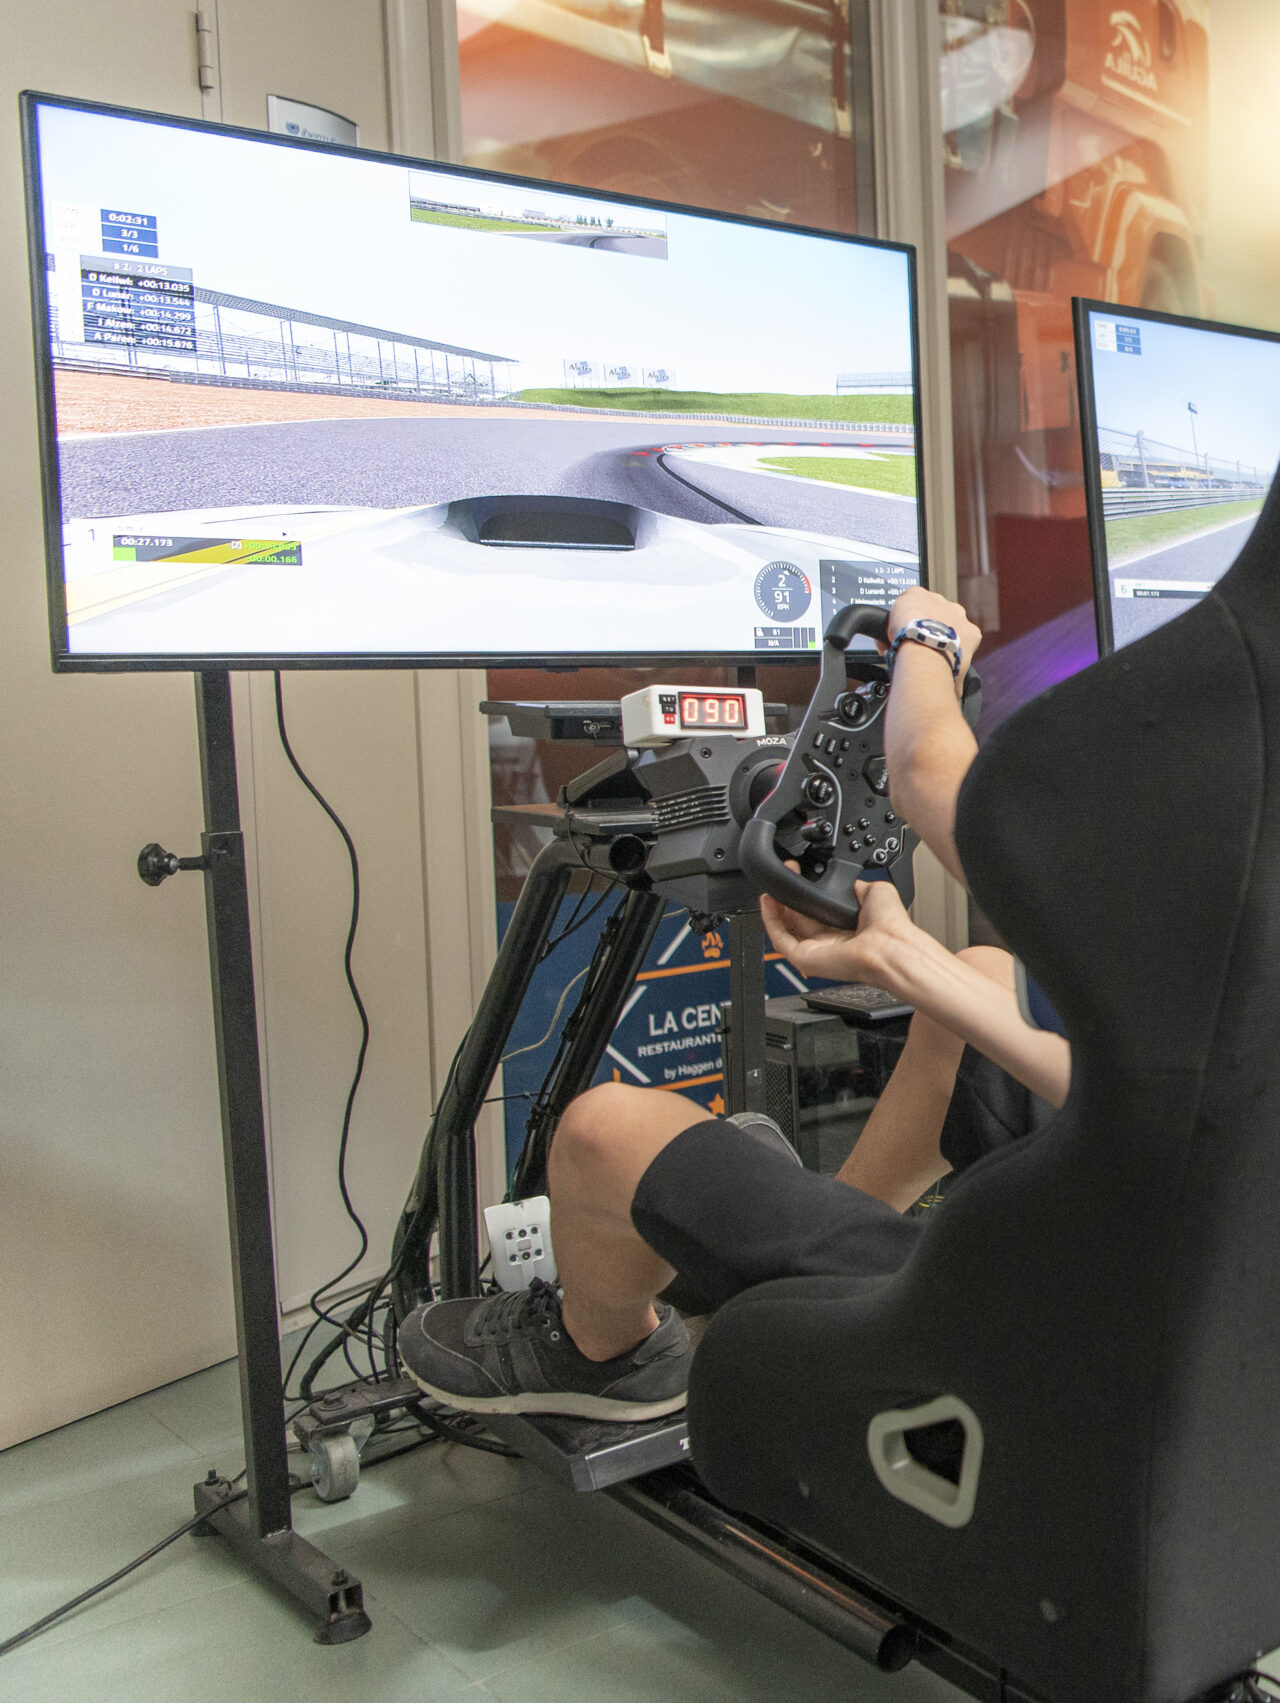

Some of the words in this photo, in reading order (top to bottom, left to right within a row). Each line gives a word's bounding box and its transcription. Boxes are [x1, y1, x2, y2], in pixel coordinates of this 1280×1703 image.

[108, 213, 149, 225] 0:02:31
[120, 229, 138, 238] 3/3
[121, 244, 139, 253] 1/6
[145, 265, 168, 275] LAPS
[88, 273, 97, 281] D
[137, 280, 190, 292] +00:13.035
[92, 288, 100, 296] D
[139, 294, 191, 306] +00:13.544
[140, 309, 192, 321] +00:14.299
[120, 538, 173, 547] 00:27.173
[778, 574, 786, 587] 2
[774, 591, 790, 604] 91
[682, 698, 739, 723] 090
[756, 737, 787, 746] MOZA
[649, 1010, 679, 1036] LA
[664, 1067, 677, 1080] by
[678, 1062, 715, 1076] Haggen
